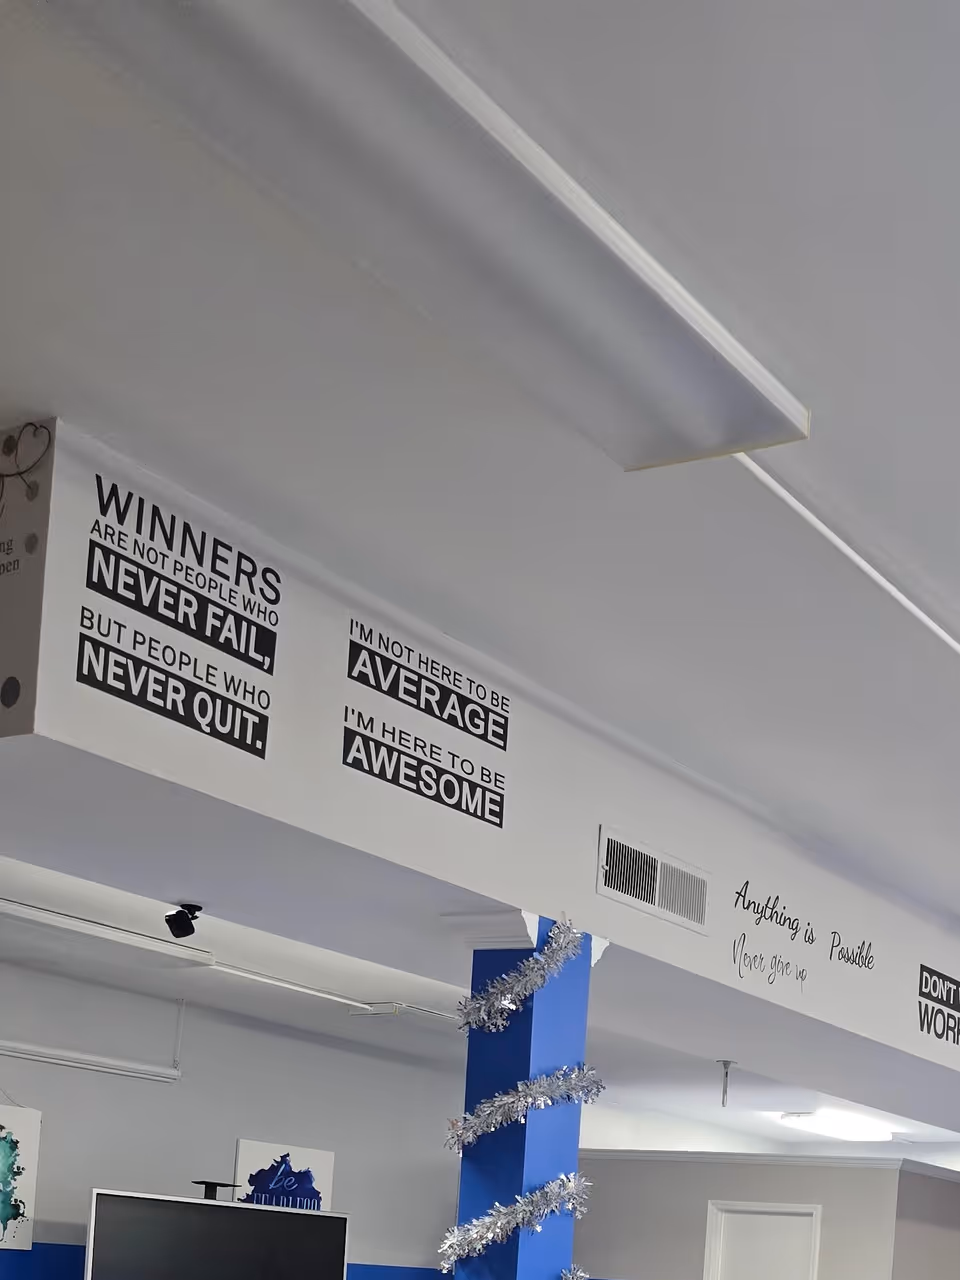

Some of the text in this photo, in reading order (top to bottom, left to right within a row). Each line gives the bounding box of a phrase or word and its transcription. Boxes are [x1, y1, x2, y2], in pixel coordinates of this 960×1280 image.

[90, 519, 279, 627] ARE NOT PEOPLE WHO
[95, 473, 282, 605] WINNERS
[92, 546, 271, 670] NEVER FAIL,
[80, 605, 271, 710] BUT PEOPLE WHO
[82, 640, 263, 750] NEVER QUIT.
[350, 618, 511, 714] I'M NOT HERE TO BE
[351, 649, 505, 747] AVERAGE
[344, 705, 505, 791] I'M HERE TO BE
[346, 735, 501, 825] AWESOME
[732, 932, 808, 994] Never give up
[734, 880, 875, 970] Anything is Possible
[921, 971, 957, 1004] DON'T
[269, 1163, 298, 1190] be
